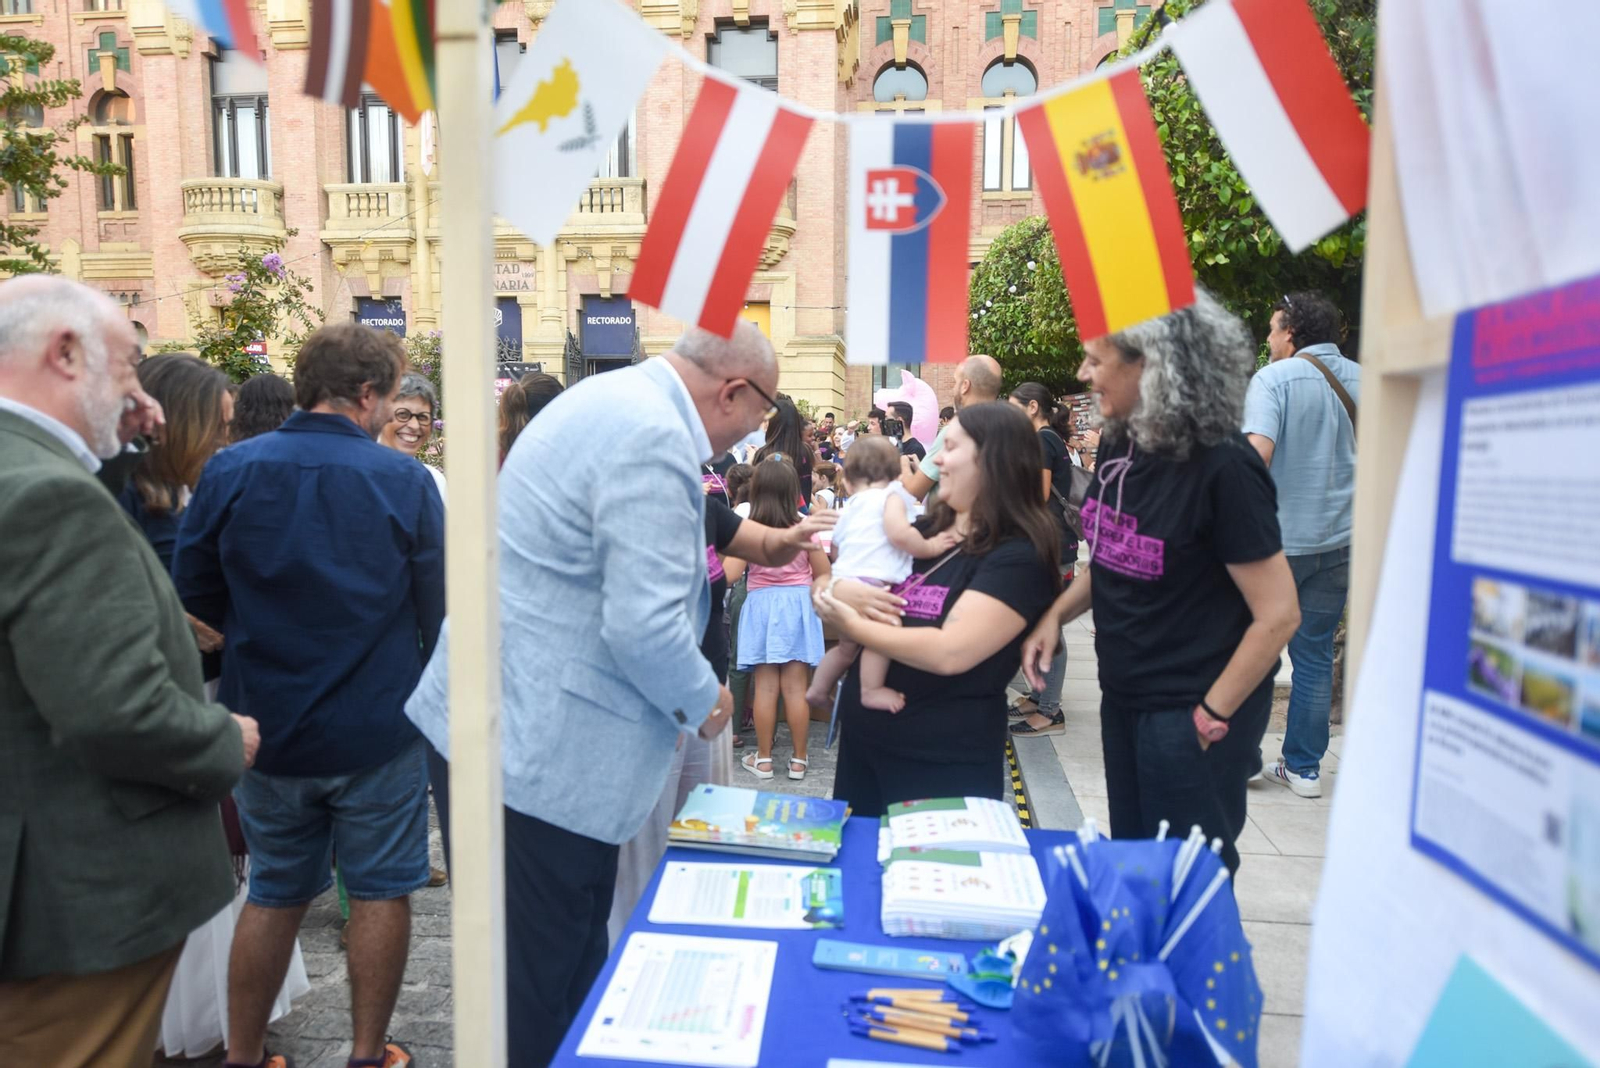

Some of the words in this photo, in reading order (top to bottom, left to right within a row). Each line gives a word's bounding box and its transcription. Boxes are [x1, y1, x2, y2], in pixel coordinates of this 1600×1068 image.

[494, 263, 520, 275] TAD
[493, 280, 529, 290] NARIA
[361, 318, 404, 326] RECTORADO
[587, 316, 632, 325] RECTORADO
